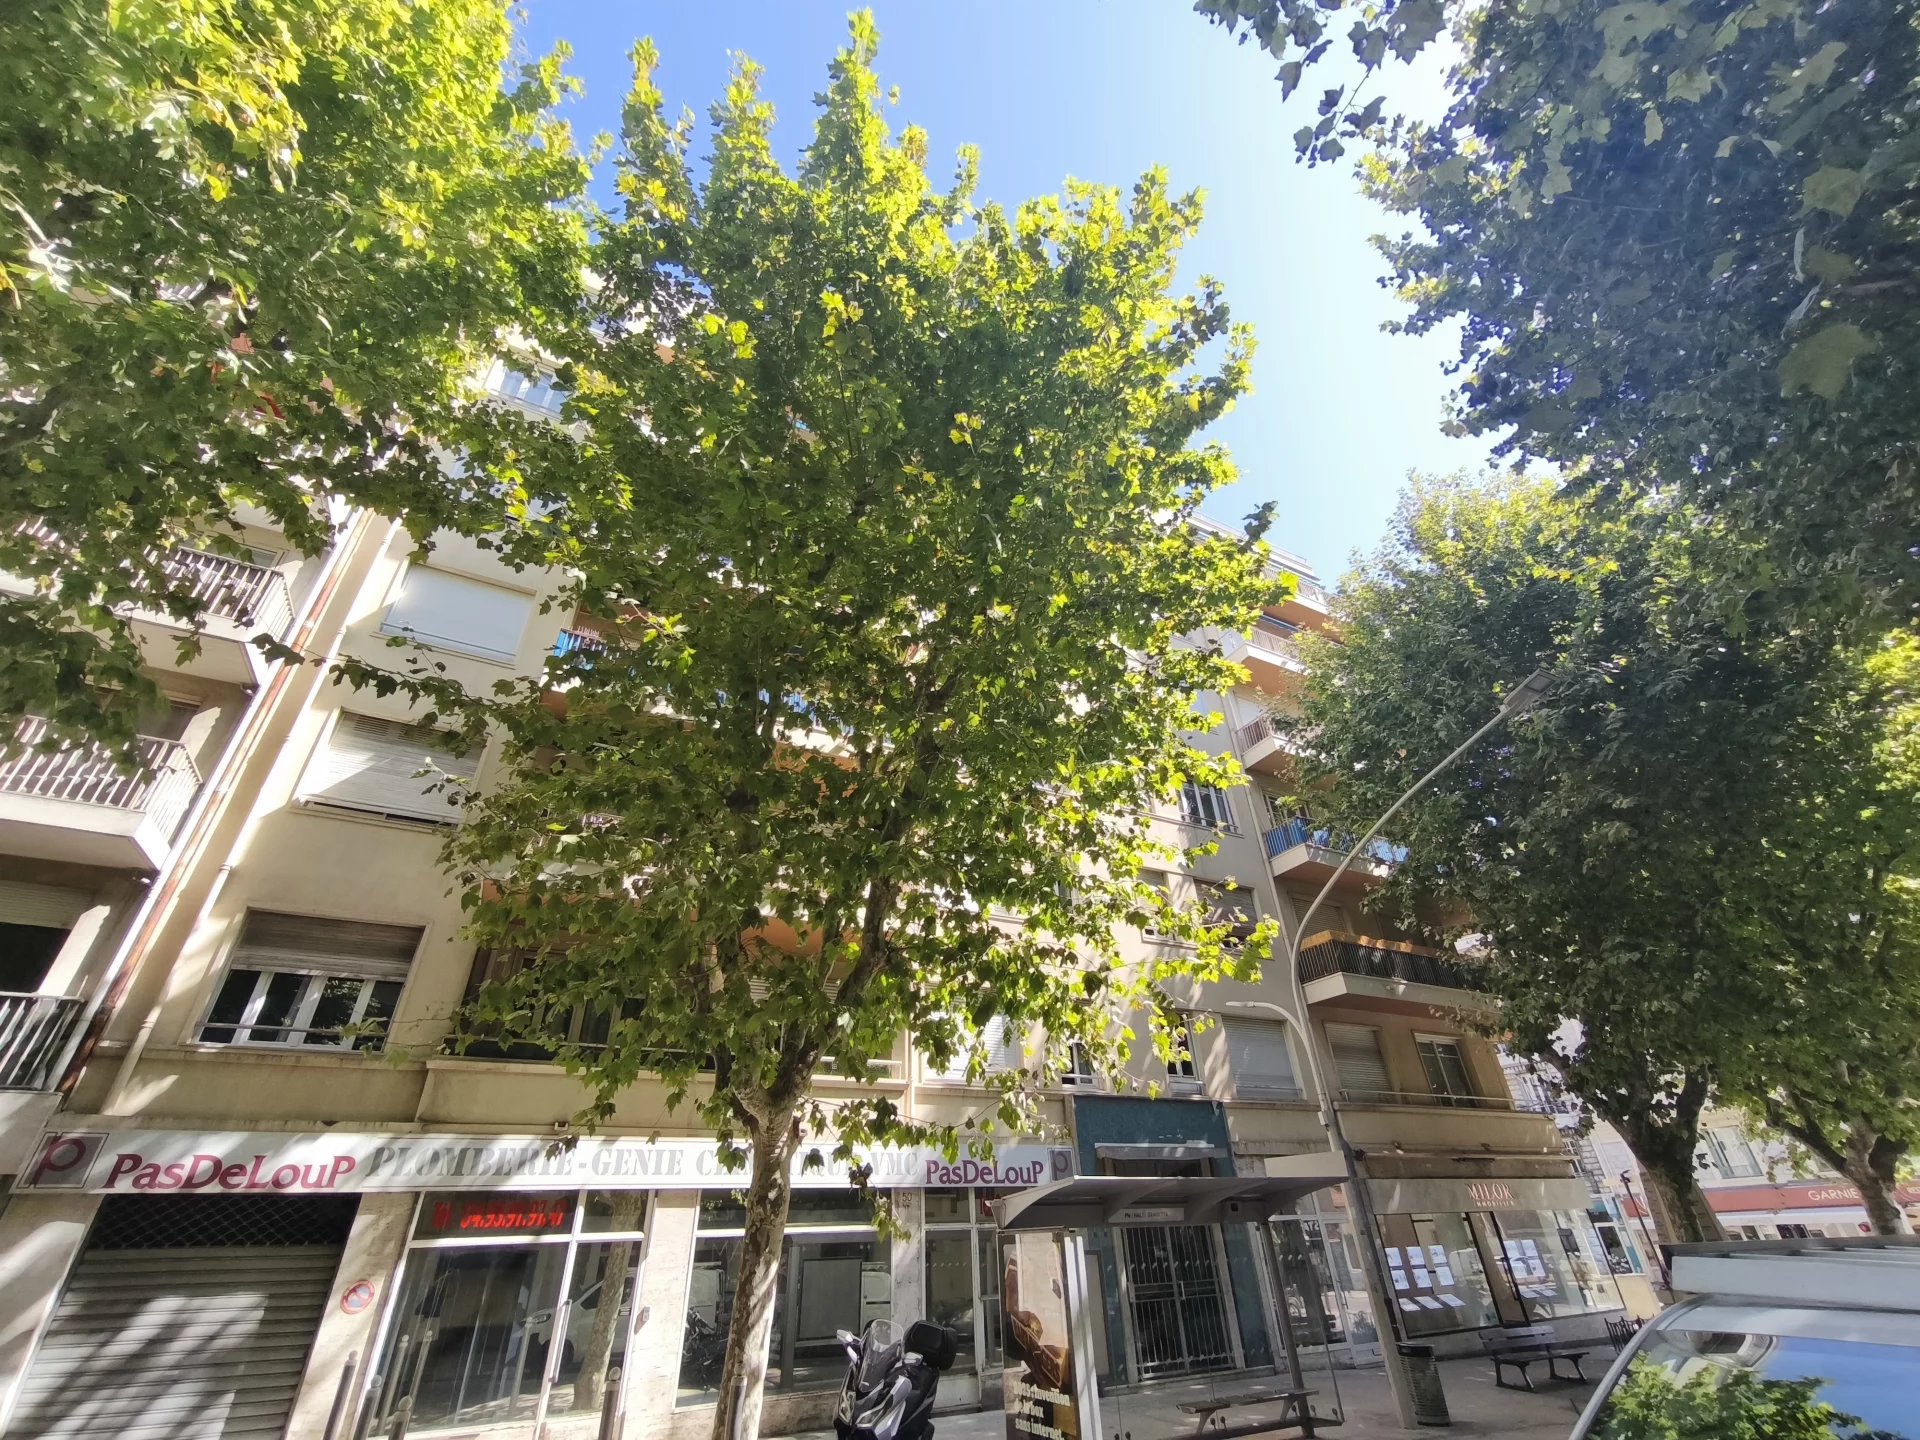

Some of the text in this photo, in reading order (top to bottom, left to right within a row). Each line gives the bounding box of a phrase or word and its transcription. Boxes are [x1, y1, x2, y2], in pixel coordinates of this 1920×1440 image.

[102, 1154, 356, 1190] PasDeLouP
[925, 1159, 1044, 1185] PasDeLouP
[1466, 1183, 1516, 1200] MILOR
